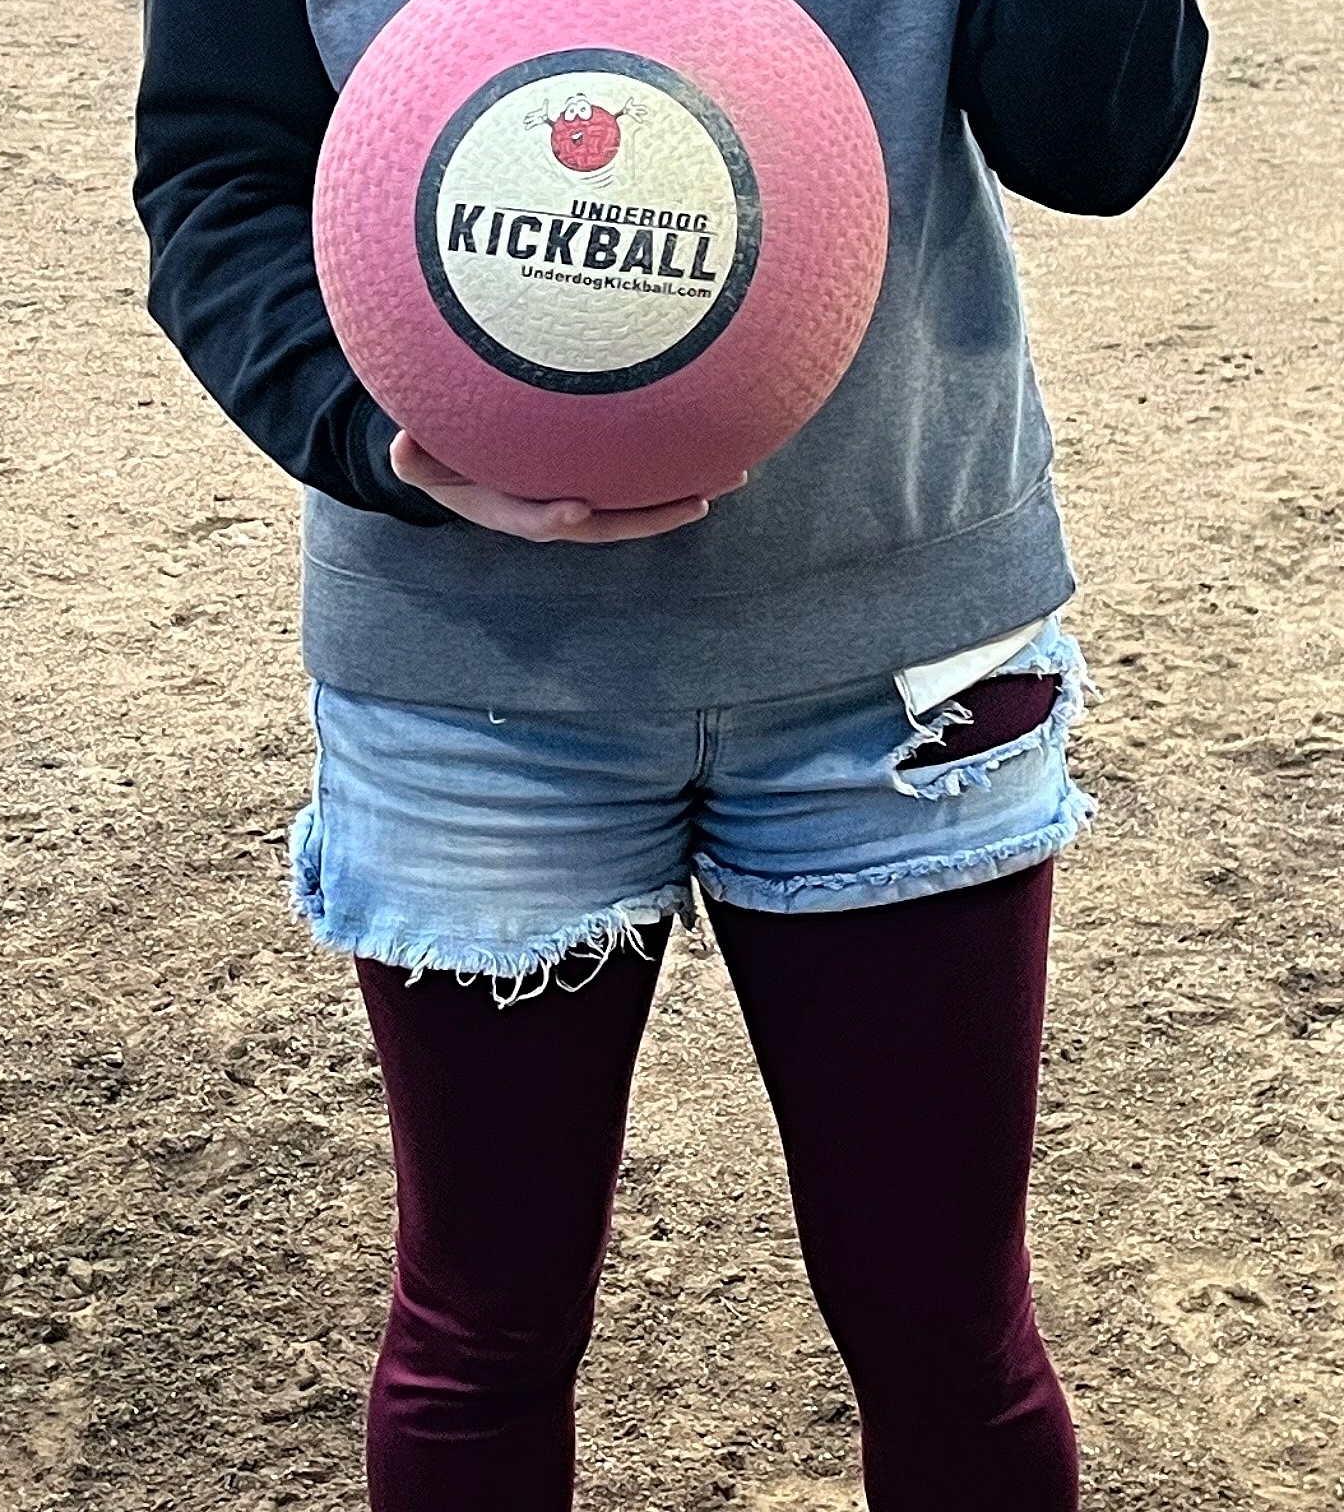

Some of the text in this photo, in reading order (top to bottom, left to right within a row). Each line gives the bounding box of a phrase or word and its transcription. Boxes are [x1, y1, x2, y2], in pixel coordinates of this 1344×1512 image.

[570, 199, 709, 231] UNDERDOG
[447, 203, 717, 282] KICKBALL
[521, 265, 712, 299] UnderdogKickball.com
